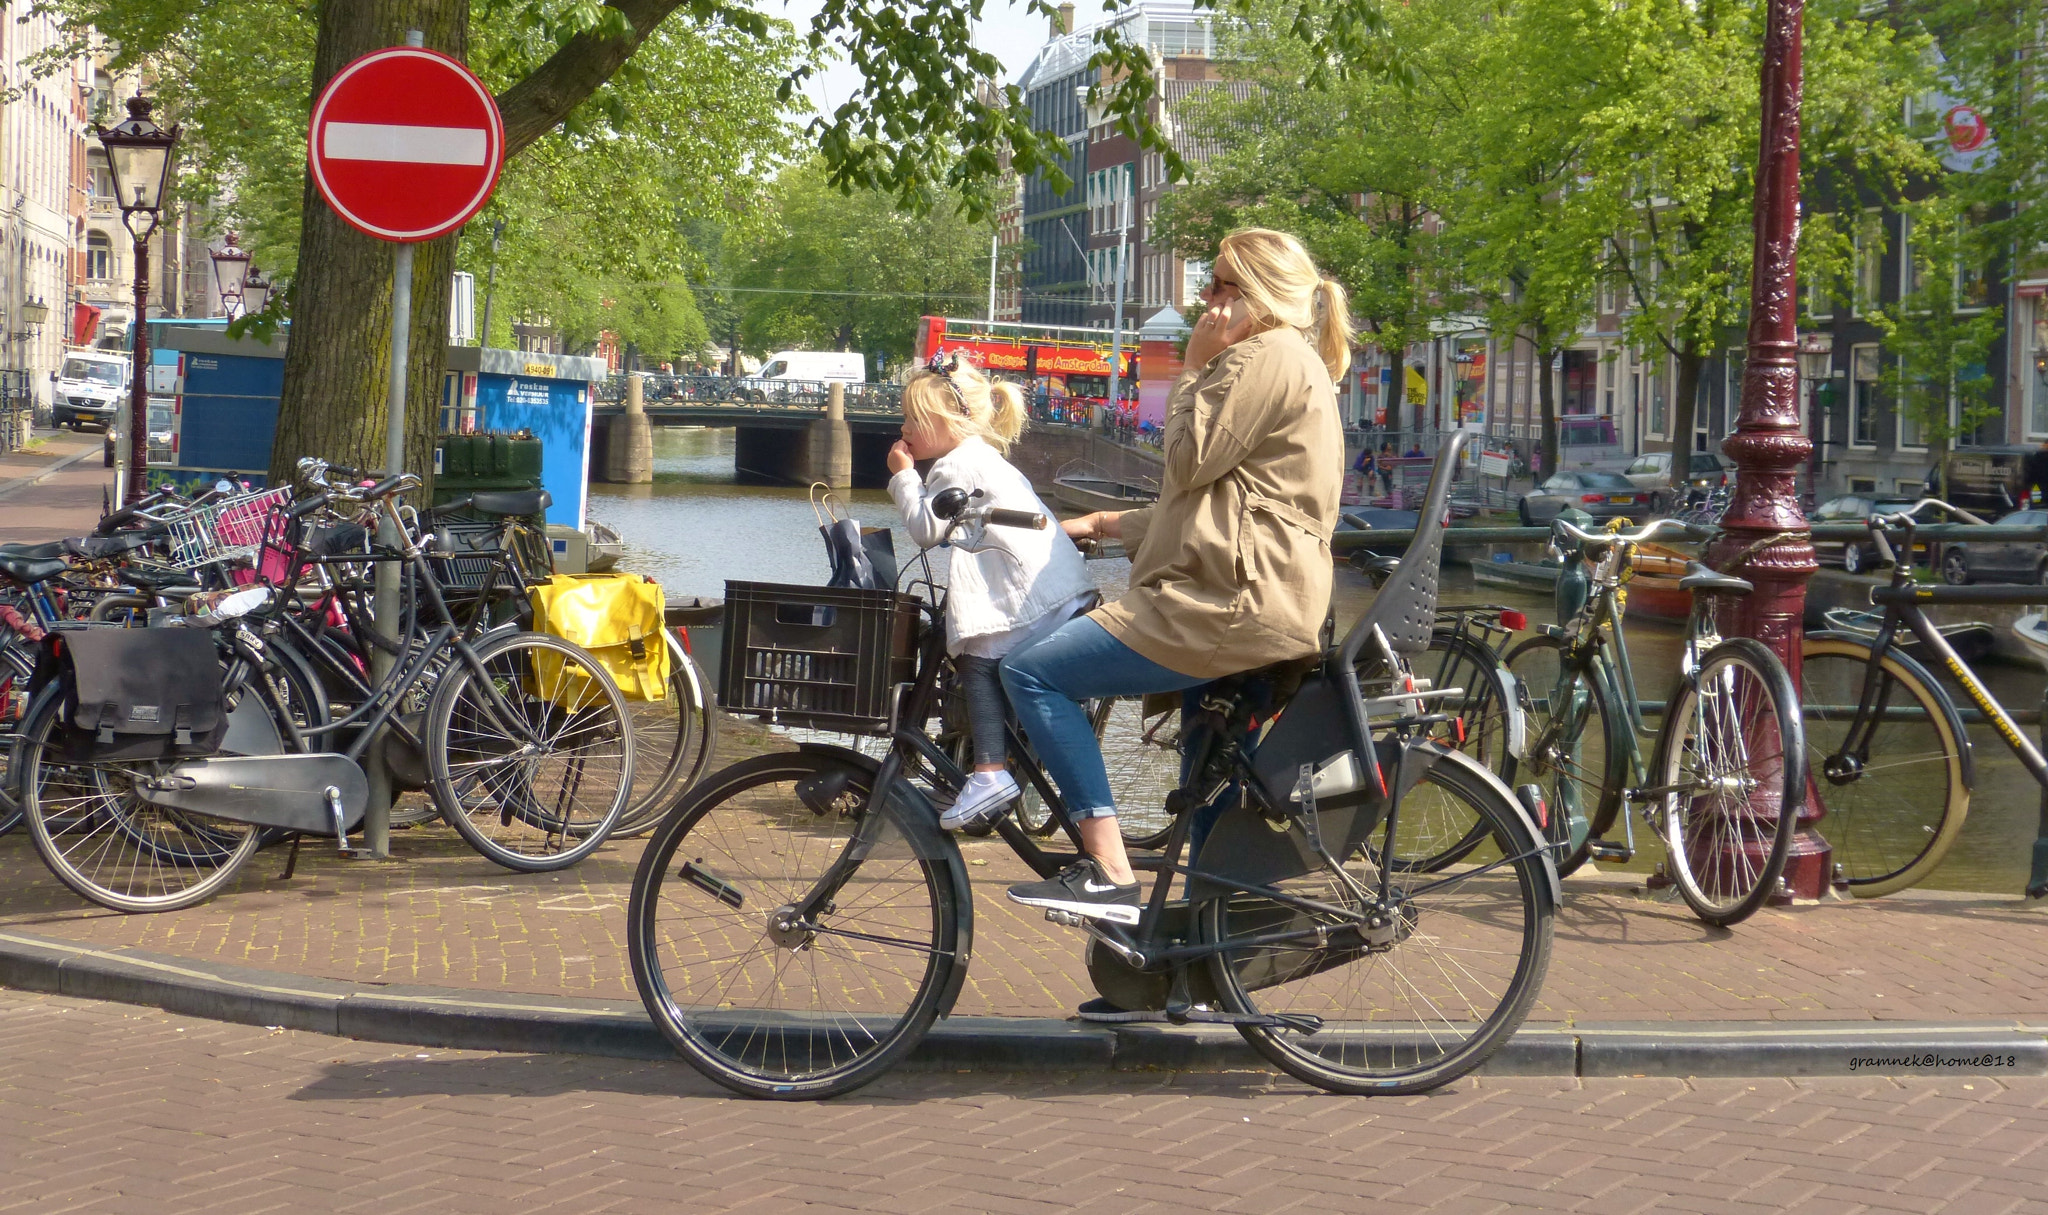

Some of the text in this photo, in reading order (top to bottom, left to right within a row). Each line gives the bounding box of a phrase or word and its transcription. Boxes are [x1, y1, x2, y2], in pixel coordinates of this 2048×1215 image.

[1053, 356, 1111, 373] Amsterdam
[519, 383, 549, 391] roskam
[1946, 657, 2022, 748] THE STUDENT HOTEL
